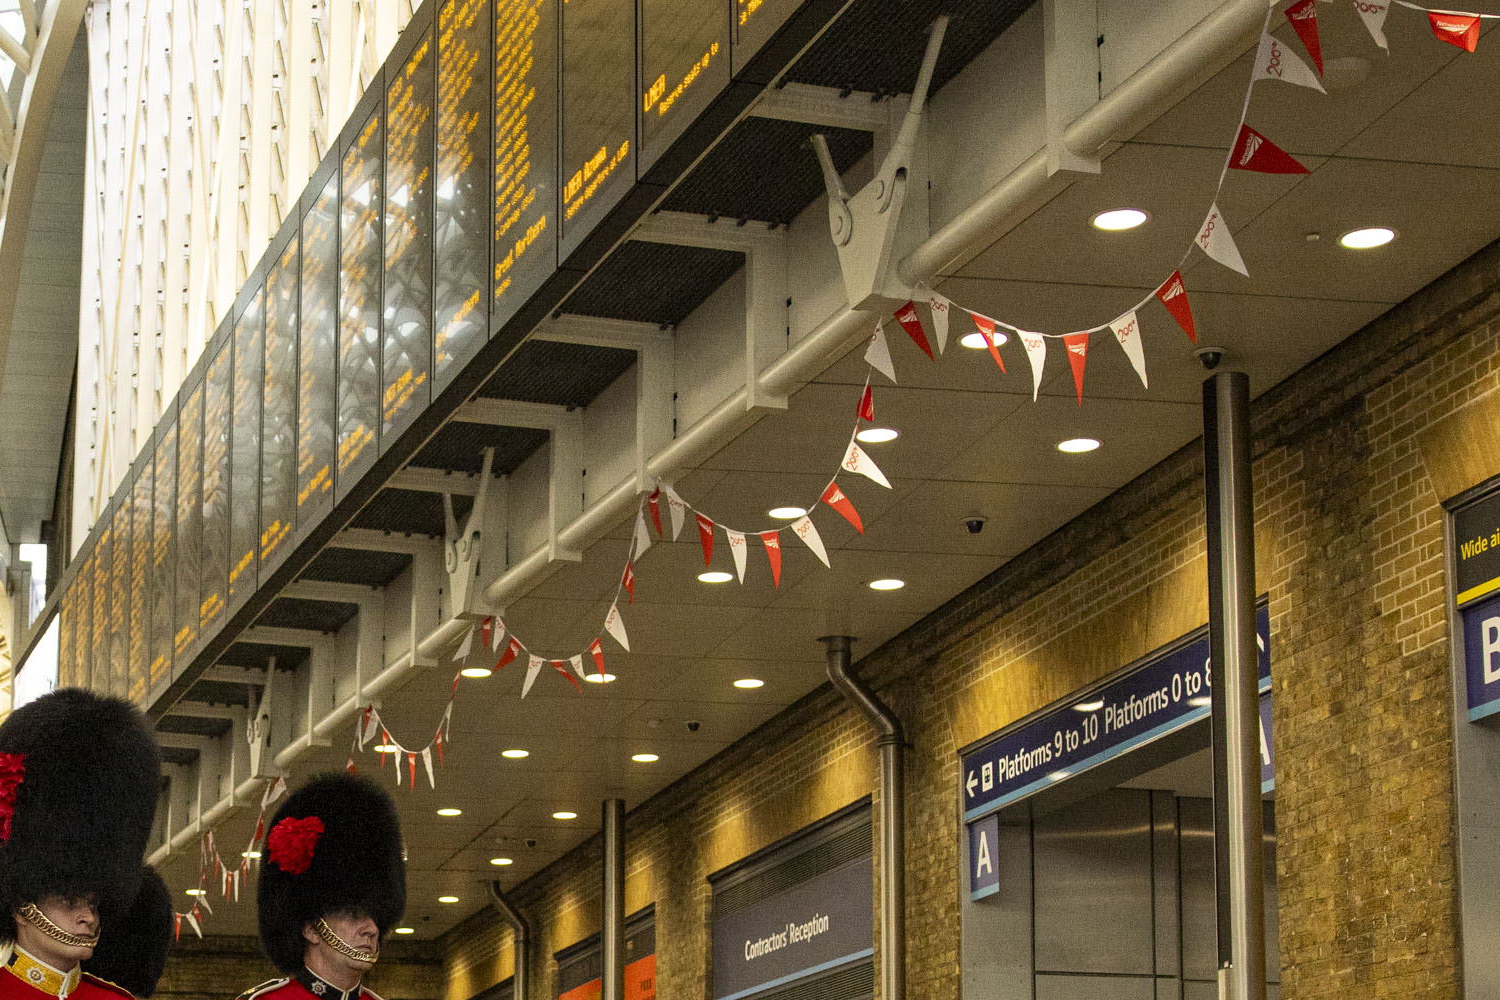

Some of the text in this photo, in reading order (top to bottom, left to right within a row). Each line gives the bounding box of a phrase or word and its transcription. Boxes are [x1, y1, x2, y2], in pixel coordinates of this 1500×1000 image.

[1460, 536, 1488, 560] Wide
[998, 742, 1052, 784] Platforms
[1054, 731, 1063, 757] 9
[1065, 729, 1079, 751] to
[1082, 713, 1098, 745] 10
[1105, 686, 1169, 734] Platforms
[1172, 673, 1181, 703] 0
[1185, 671, 1201, 696] to
[976, 831, 992, 878] A
[789, 913, 829, 944] Reception
